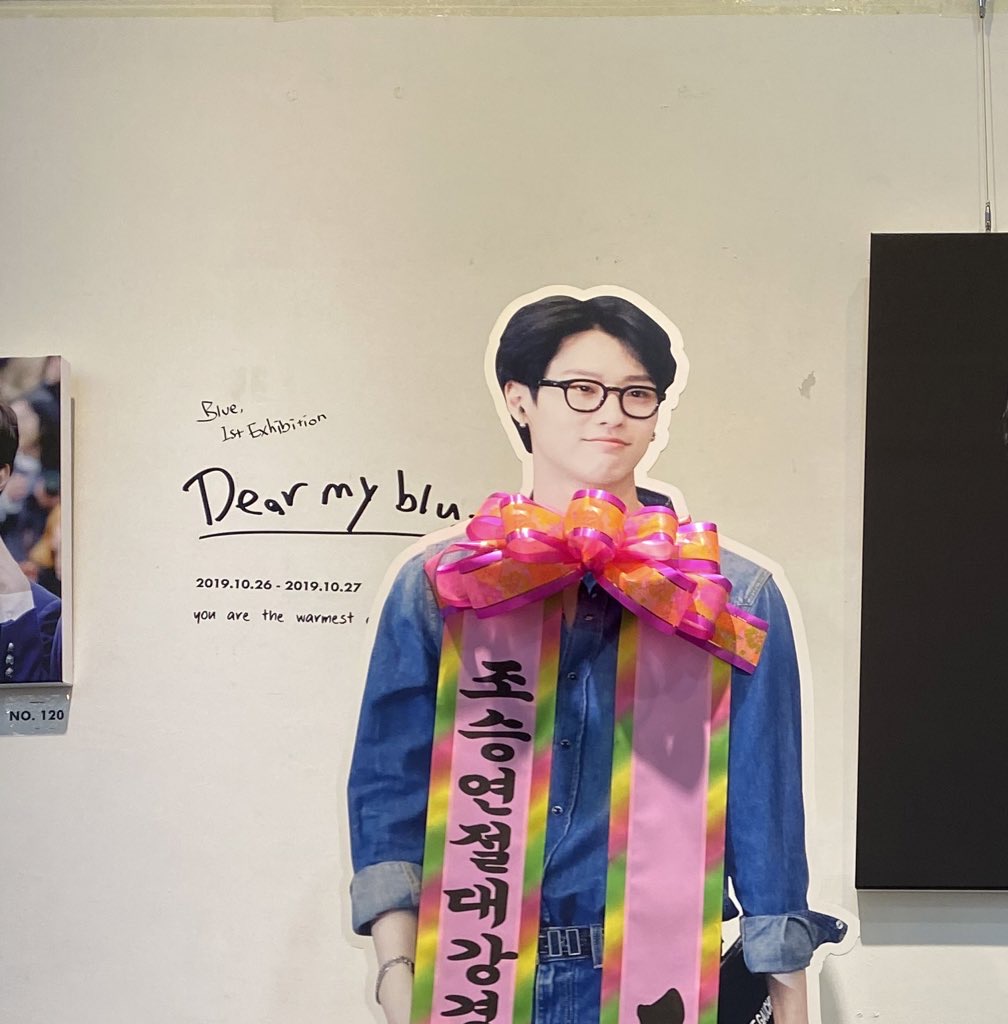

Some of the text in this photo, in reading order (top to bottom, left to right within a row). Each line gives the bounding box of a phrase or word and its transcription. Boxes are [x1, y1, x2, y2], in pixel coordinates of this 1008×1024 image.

[196, 400, 244, 422] Blue,
[221, 413, 327, 442] 1st Exhibition
[182, 467, 475, 532] Dear my blu
[196, 577, 272, 590] 2019.10.26
[285, 580, 362, 593] 2019.10.27
[193, 610, 216, 624] you
[226, 611, 250, 622] are
[262, 609, 284, 623] the
[296, 611, 355, 625] warmest
[9, 709, 65, 721] NO. 120
